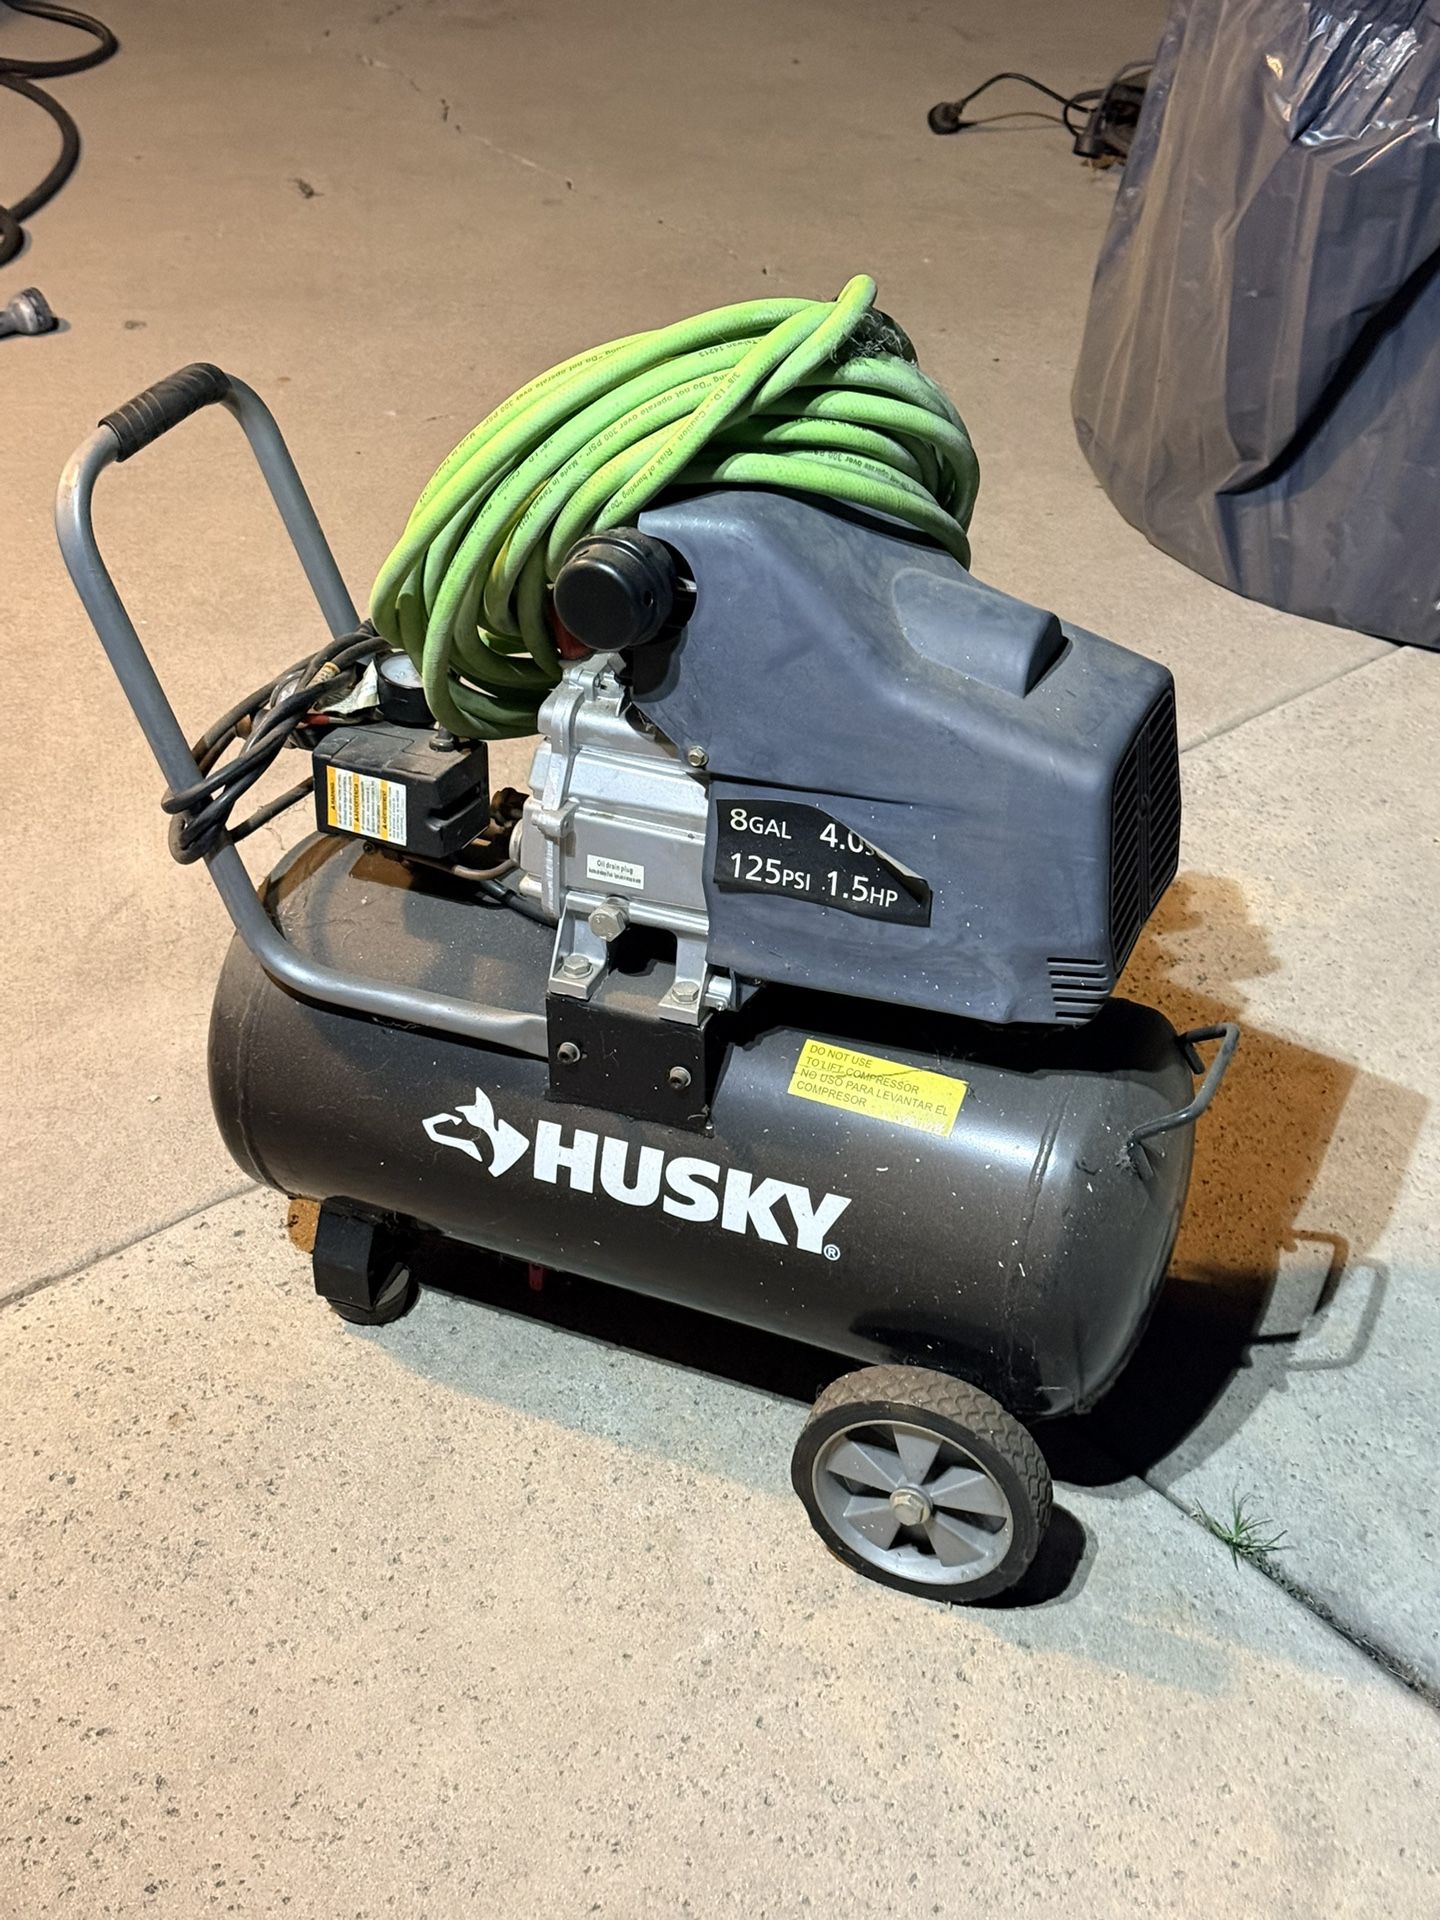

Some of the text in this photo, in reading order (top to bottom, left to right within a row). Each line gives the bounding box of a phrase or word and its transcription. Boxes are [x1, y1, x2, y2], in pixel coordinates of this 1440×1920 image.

[620, 413, 638, 429] over
[603, 427, 619, 441] 300
[656, 447, 673, 465] Risk
[845, 456, 862, 467] over
[649, 465, 656, 476] of
[622, 473, 649, 499] bursting
[730, 808, 792, 840] 8GAL
[606, 862, 620, 870] drain
[621, 865, 634, 875] plug
[730, 852, 898, 908] 125PSI 1.5HP
[809, 1045, 873, 1068] DO NOT USE
[805, 1057, 920, 1094] TO LIFT COMPRESSOR
[796, 1080, 867, 1107] COMPRESOR
[800, 1067, 949, 1116] NO USO PARA LEVANTAR EL
[533, 1118, 852, 1255] HUSKY
